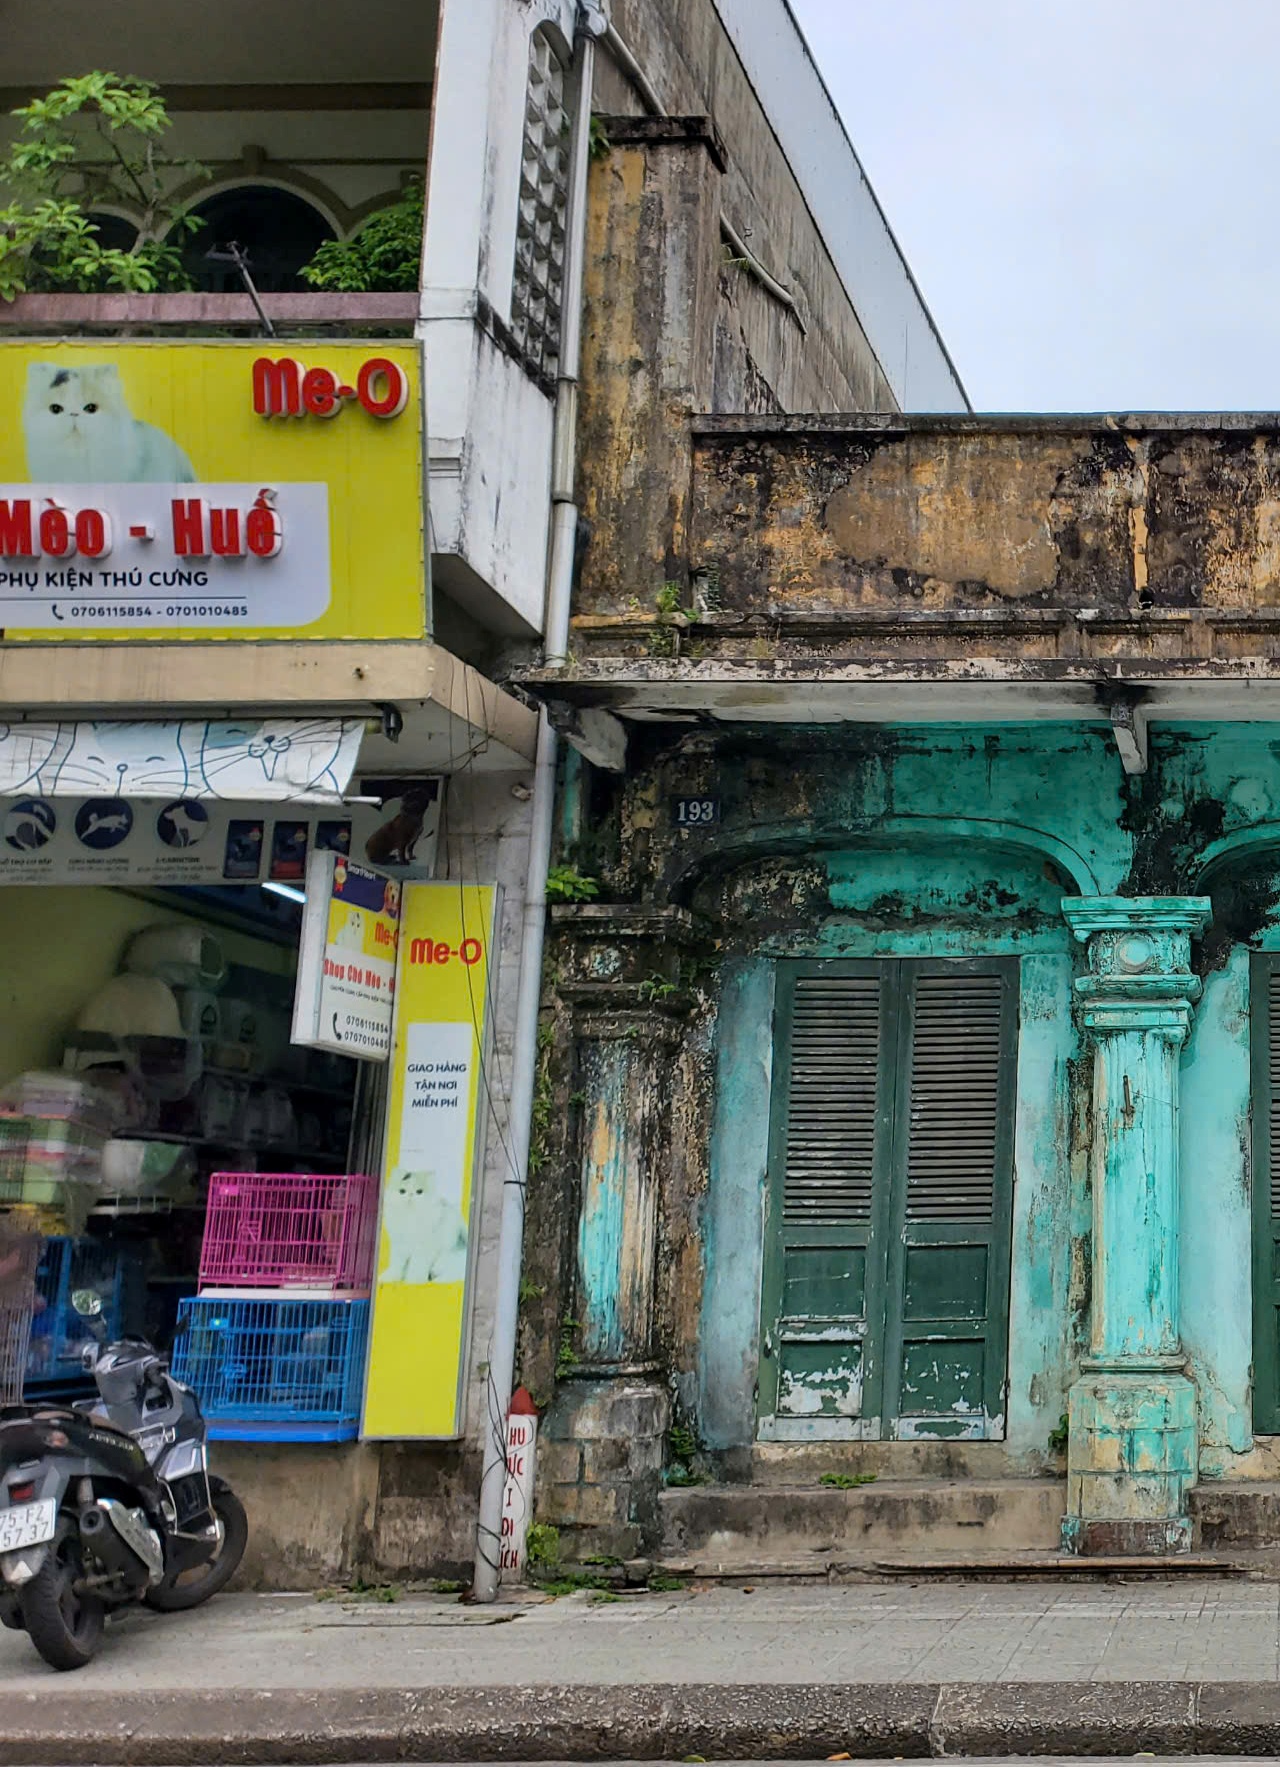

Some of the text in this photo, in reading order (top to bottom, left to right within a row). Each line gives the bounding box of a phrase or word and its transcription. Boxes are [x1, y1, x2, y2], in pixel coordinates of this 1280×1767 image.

[253, 357, 405, 416] Me-O
[0, 498, 106, 557] Mèo
[171, 488, 278, 556] Huế
[0, 567, 208, 591] PHỤ KIỆN THÚ CƯNG
[71, 606, 152, 617] 0706115854
[166, 606, 248, 616] 0701010485
[678, 801, 713, 821] 193
[410, 938, 482, 965] Me-O
[407, 1060, 467, 1073] GIAO HÀNG
[415, 1078, 458, 1092] TẬN NƠI
[412, 1094, 458, 1108] MIỄN PHÍ
[510, 1427, 525, 1446] HU
[3, 1521, 49, 1547] 57.37
